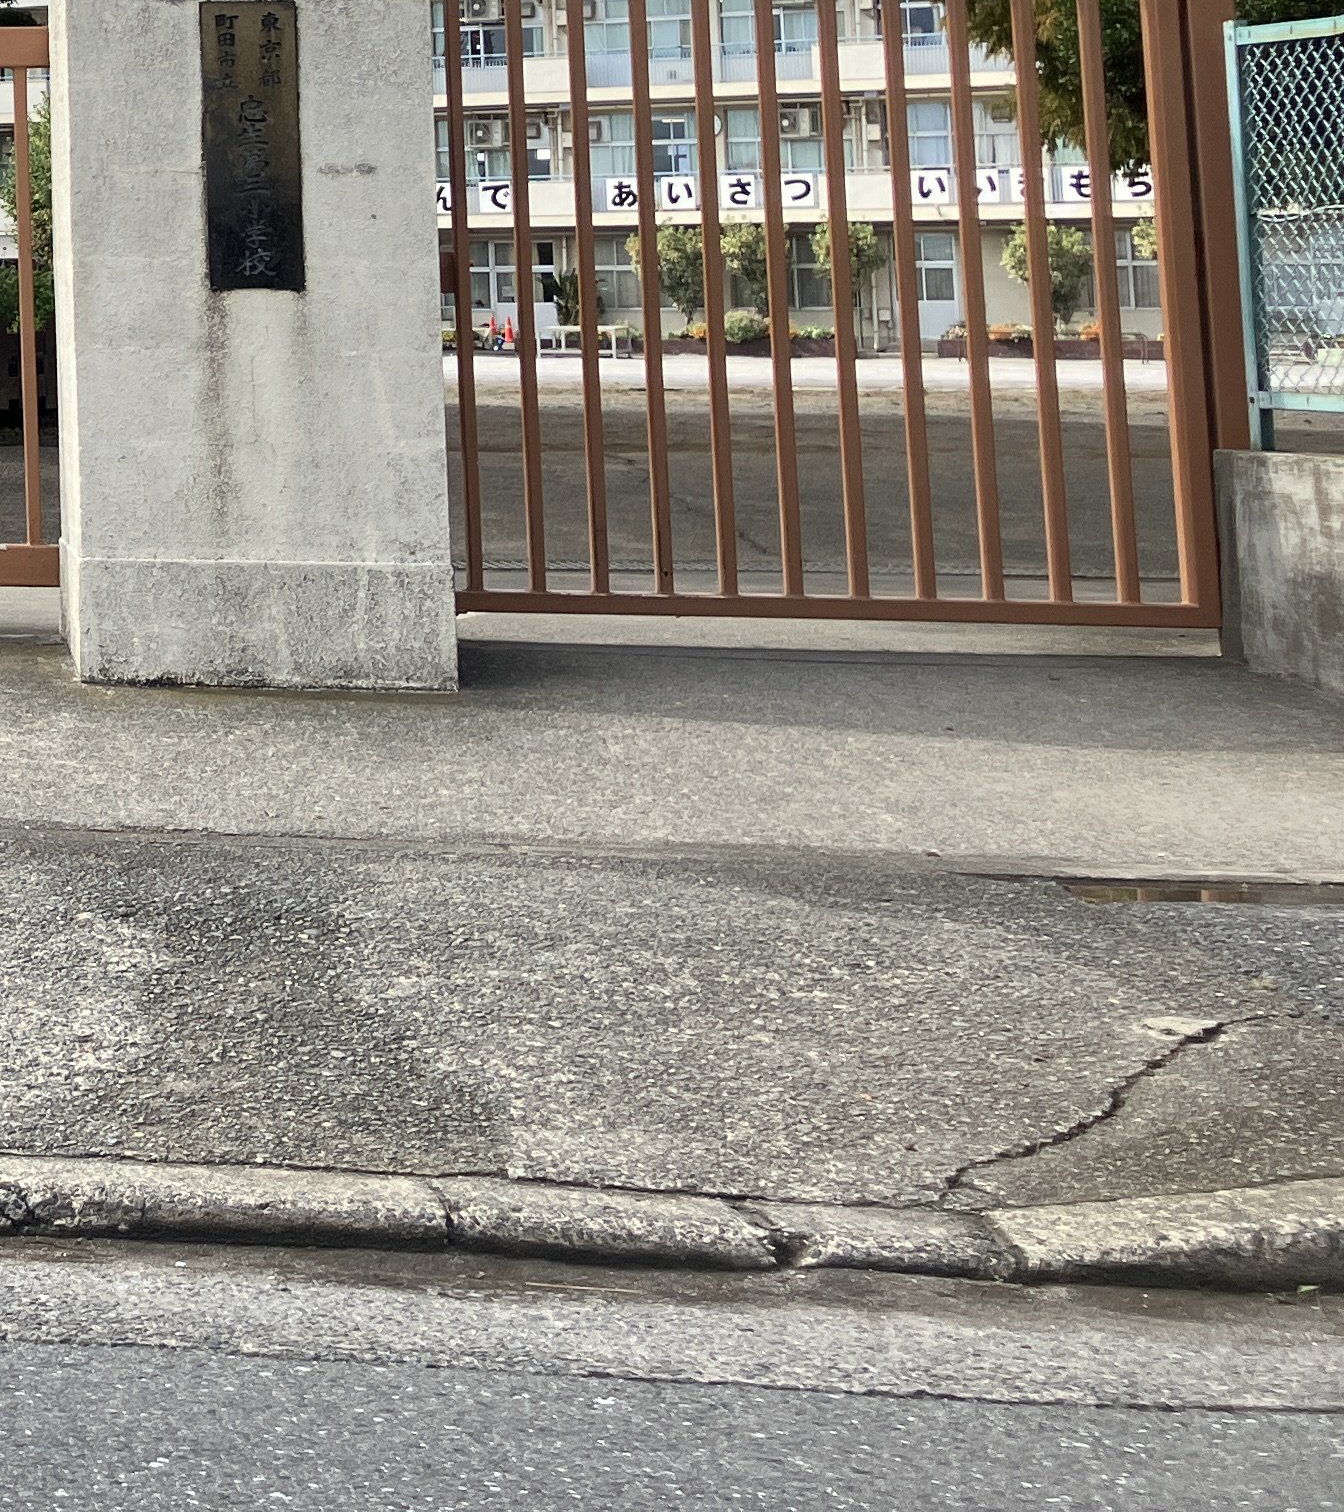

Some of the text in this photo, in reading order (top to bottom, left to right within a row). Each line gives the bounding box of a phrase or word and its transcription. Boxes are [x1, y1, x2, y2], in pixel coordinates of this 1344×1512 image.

[214, 13, 239, 89] 町田市立
[259, 11, 282, 88] 東京都
[612, 178, 811, 207] あいさつ
[918, 169, 1153, 199] いもち
